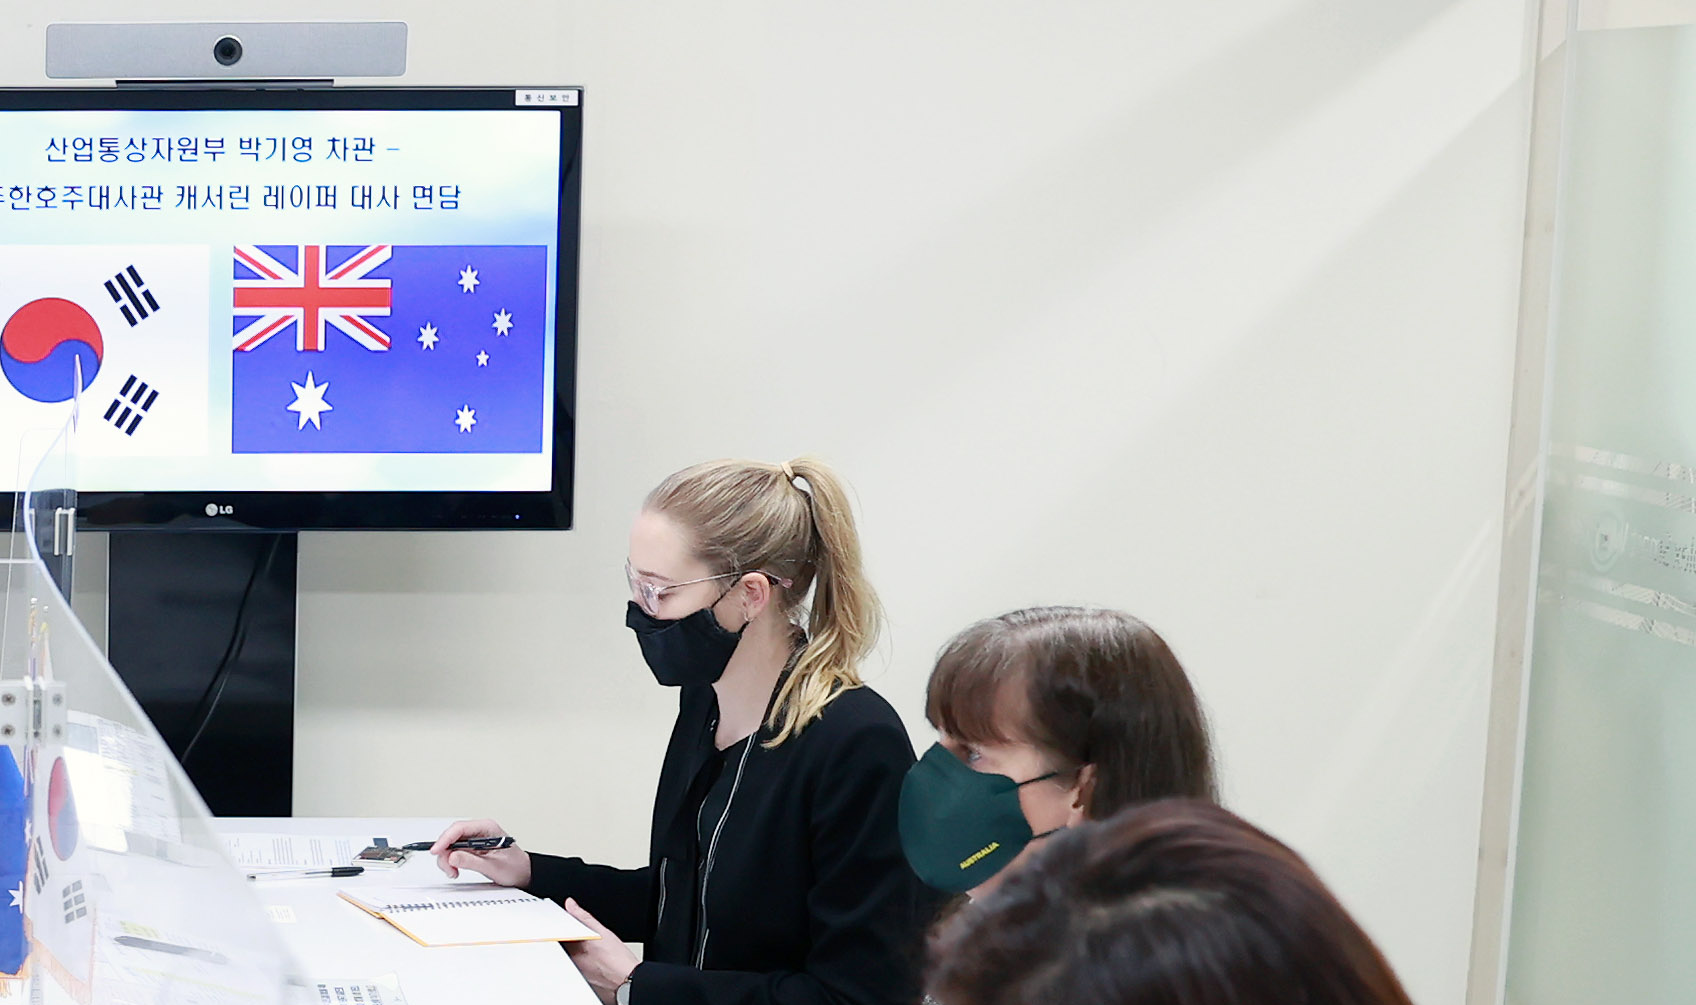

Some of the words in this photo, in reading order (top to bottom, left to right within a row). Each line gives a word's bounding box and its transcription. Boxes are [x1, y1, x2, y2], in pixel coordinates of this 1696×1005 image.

[45, 136, 226, 163] 산업통상자원부
[239, 136, 313, 163] 박기영
[326, 136, 376, 162] 차관
[175, 185, 249, 211] 캐서린
[263, 184, 337, 210] 레이퍼
[351, 185, 400, 210] 대사
[412, 184, 462, 210] 면담
[219, 505, 234, 515] LG
[959, 841, 1001, 870] AUSTRALIA
